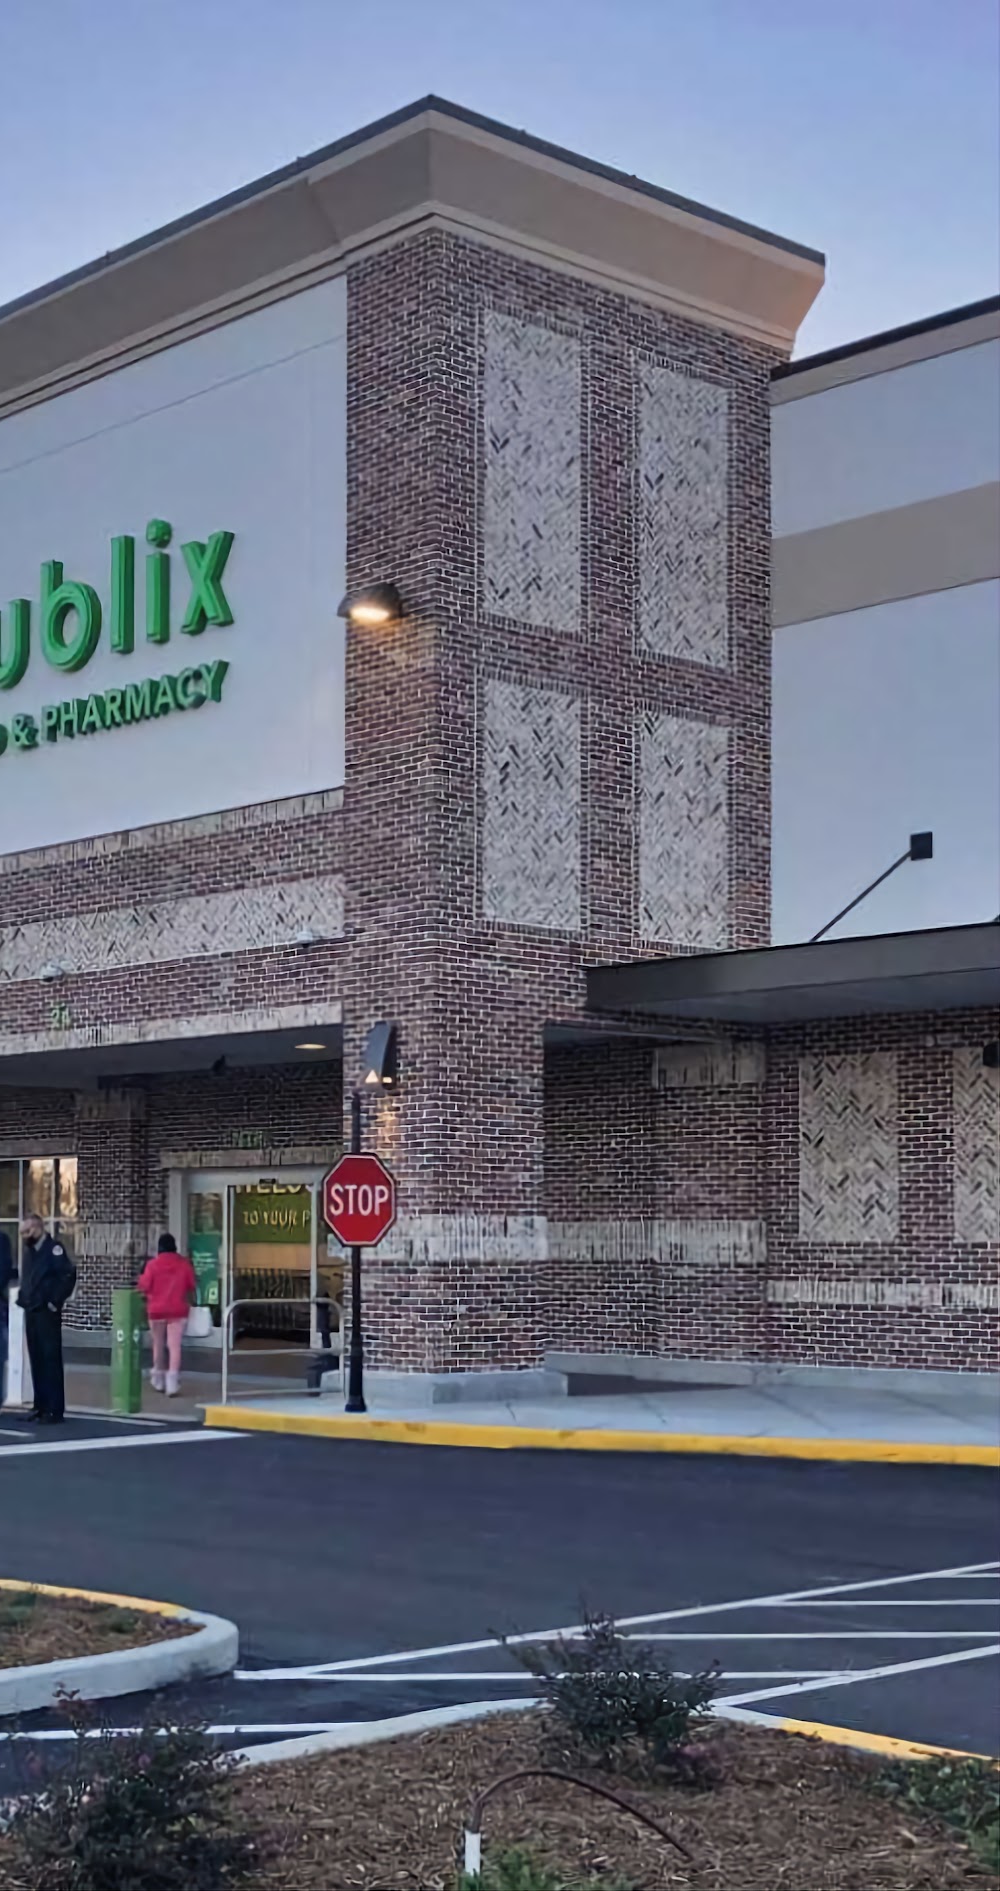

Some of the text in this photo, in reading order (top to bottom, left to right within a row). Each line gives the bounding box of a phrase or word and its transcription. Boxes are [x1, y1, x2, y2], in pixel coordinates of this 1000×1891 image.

[10, 712, 39, 751] &
[41, 659, 229, 742] PHARMACY
[329, 1183, 389, 1216] STOP
